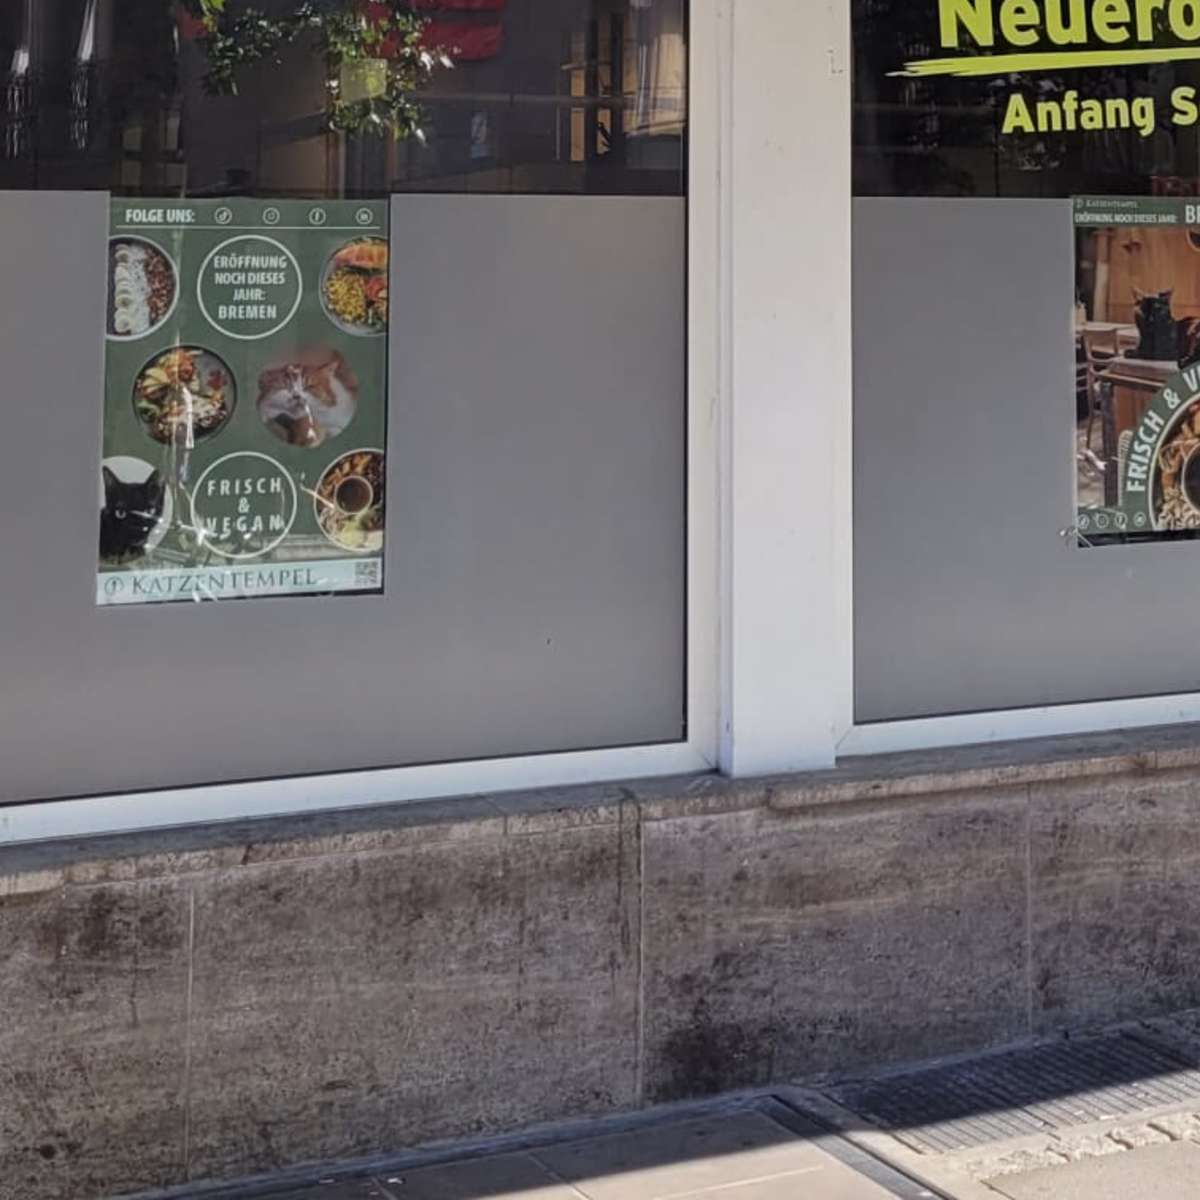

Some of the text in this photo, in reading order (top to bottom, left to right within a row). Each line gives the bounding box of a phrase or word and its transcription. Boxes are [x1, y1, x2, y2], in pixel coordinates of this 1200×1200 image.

[1002, 90, 1155, 138] Anfang
[126, 208, 195, 223] FOLGE UNS:
[213, 252, 287, 269] ERÖFFNUNG
[215, 272, 285, 285] NOCH DIESES
[233, 288, 266, 301] JAHR:
[218, 305, 277, 320] BREMEN
[1126, 411, 1164, 492] FRISCH
[1163, 388, 1181, 409] &
[207, 477, 282, 496] FRISCH
[238, 497, 250, 513] &
[206, 514, 282, 533] VEGAN
[132, 568, 319, 596] KATZENTEMPEL
